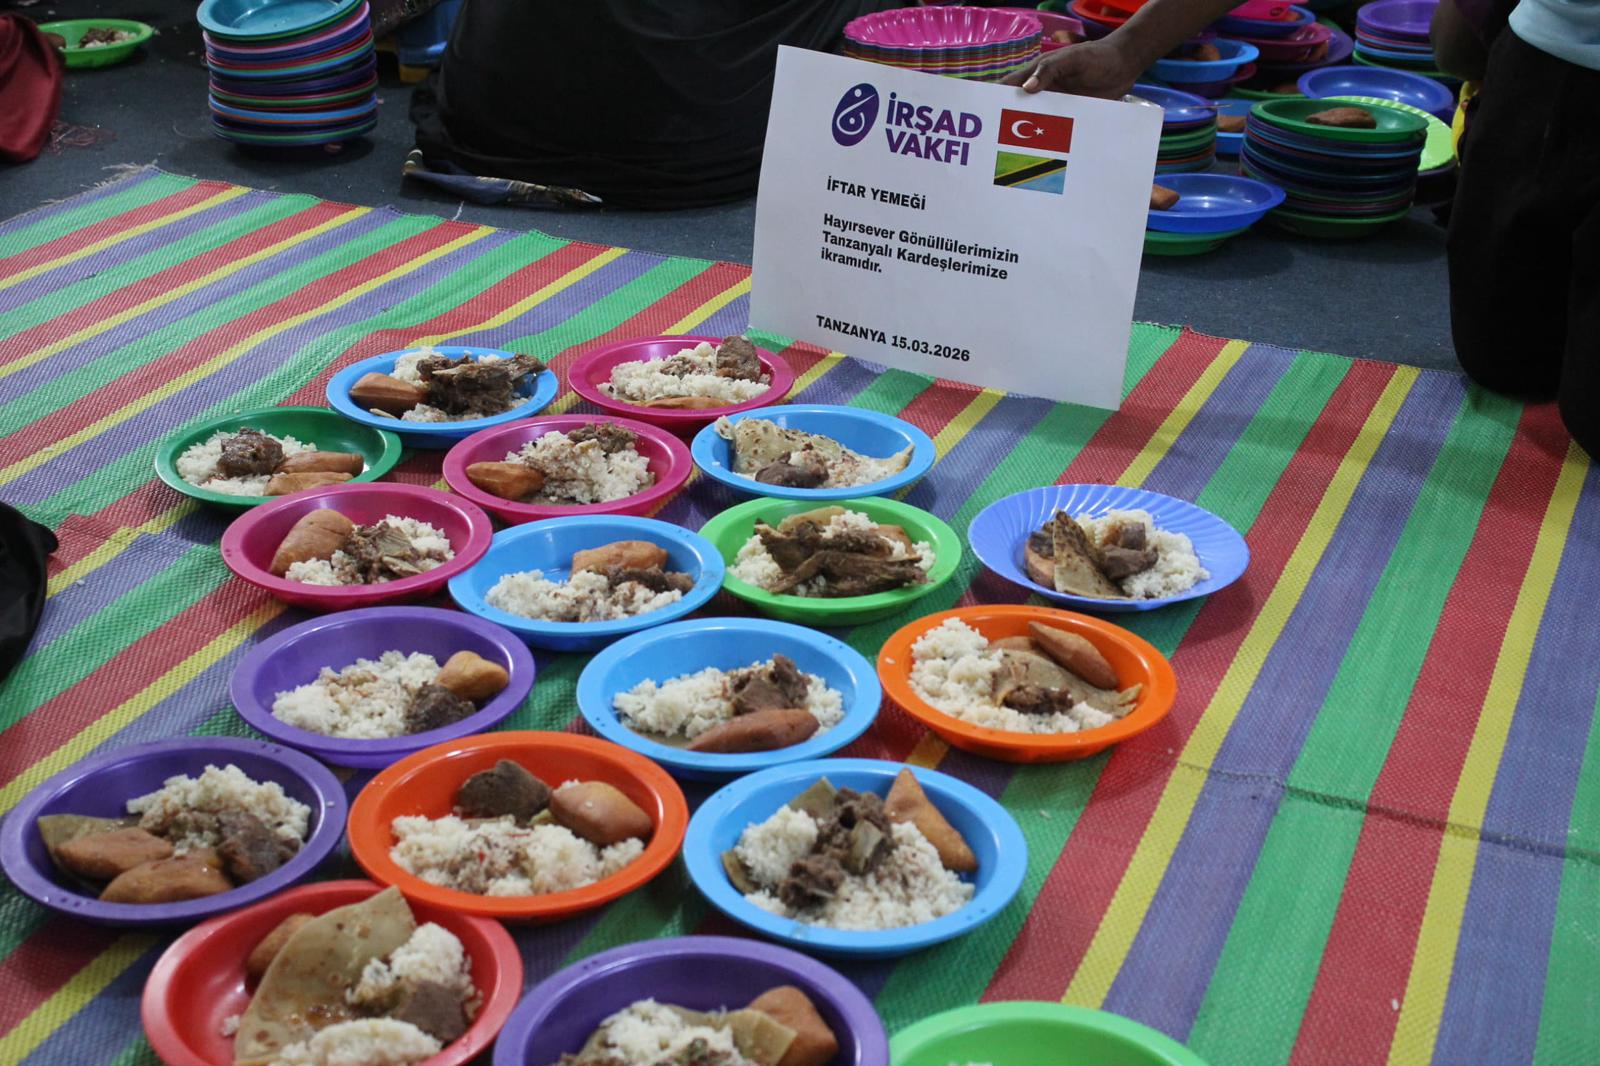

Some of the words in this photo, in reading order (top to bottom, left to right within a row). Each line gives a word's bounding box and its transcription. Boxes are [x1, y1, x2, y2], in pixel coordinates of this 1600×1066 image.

[886, 92, 982, 138] İRŞAD
[886, 128, 969, 165] VAKFI
[827, 176, 866, 198] İFTAR
[871, 188, 925, 210] YEMEĞİ
[821, 248, 881, 273] ikramıdır.
[822, 230, 892, 257] Tanzanyalı
[897, 248, 1007, 279] Kardeşlerimize
[823, 213, 895, 239] Hayırsever
[899, 231, 1018, 263] Gönüllülerimizin
[816, 315, 886, 344] TANZANYA
[892, 335, 969, 361] 15.03.2026
